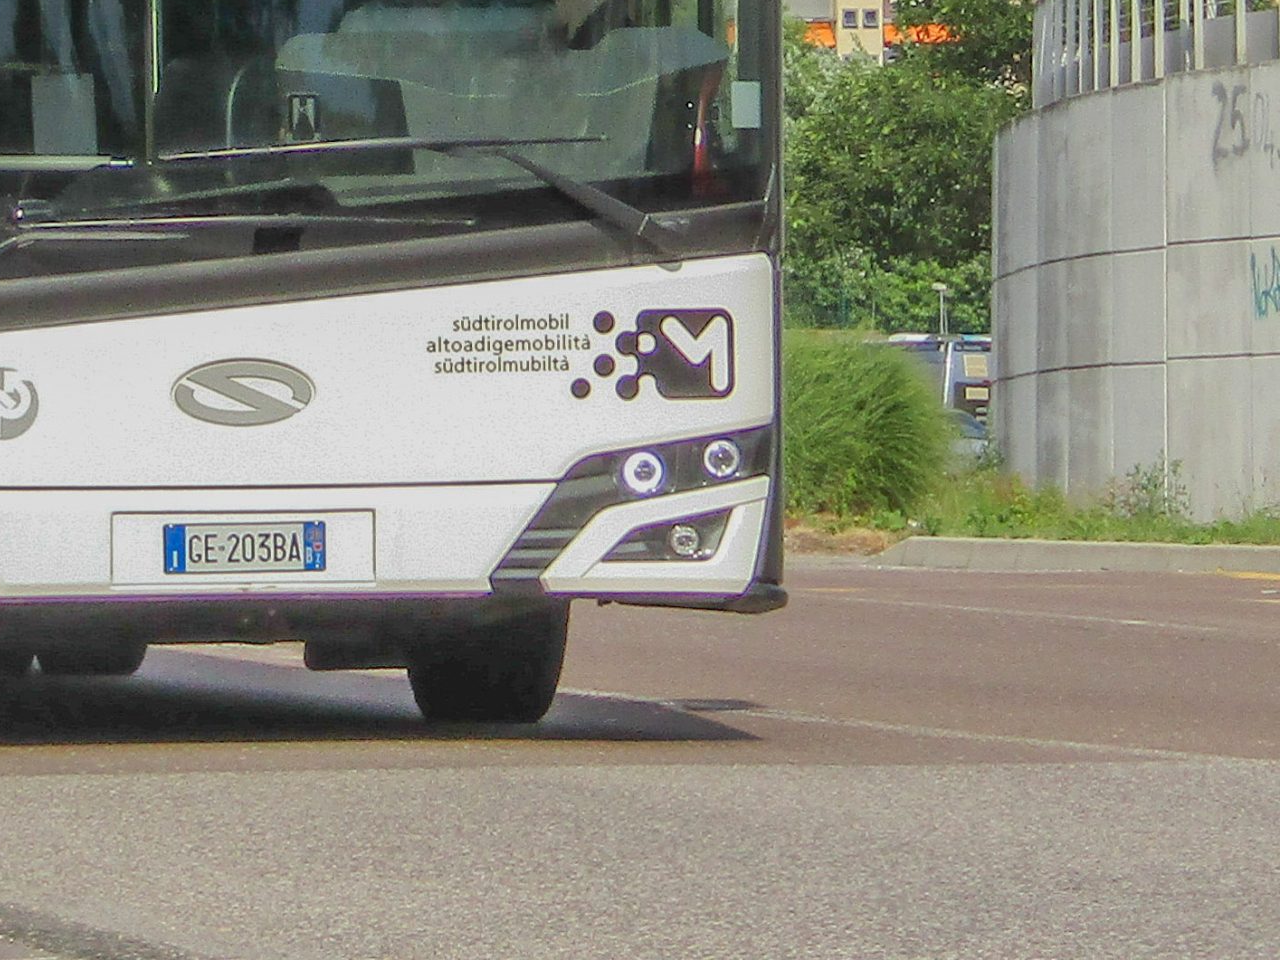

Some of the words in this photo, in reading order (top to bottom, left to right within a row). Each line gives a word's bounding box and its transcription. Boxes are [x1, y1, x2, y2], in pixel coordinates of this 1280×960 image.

[453, 313, 569, 332] südtirolmobil
[426, 334, 591, 356] altoadigemobilità
[434, 355, 570, 374] südtirolmubiltà
